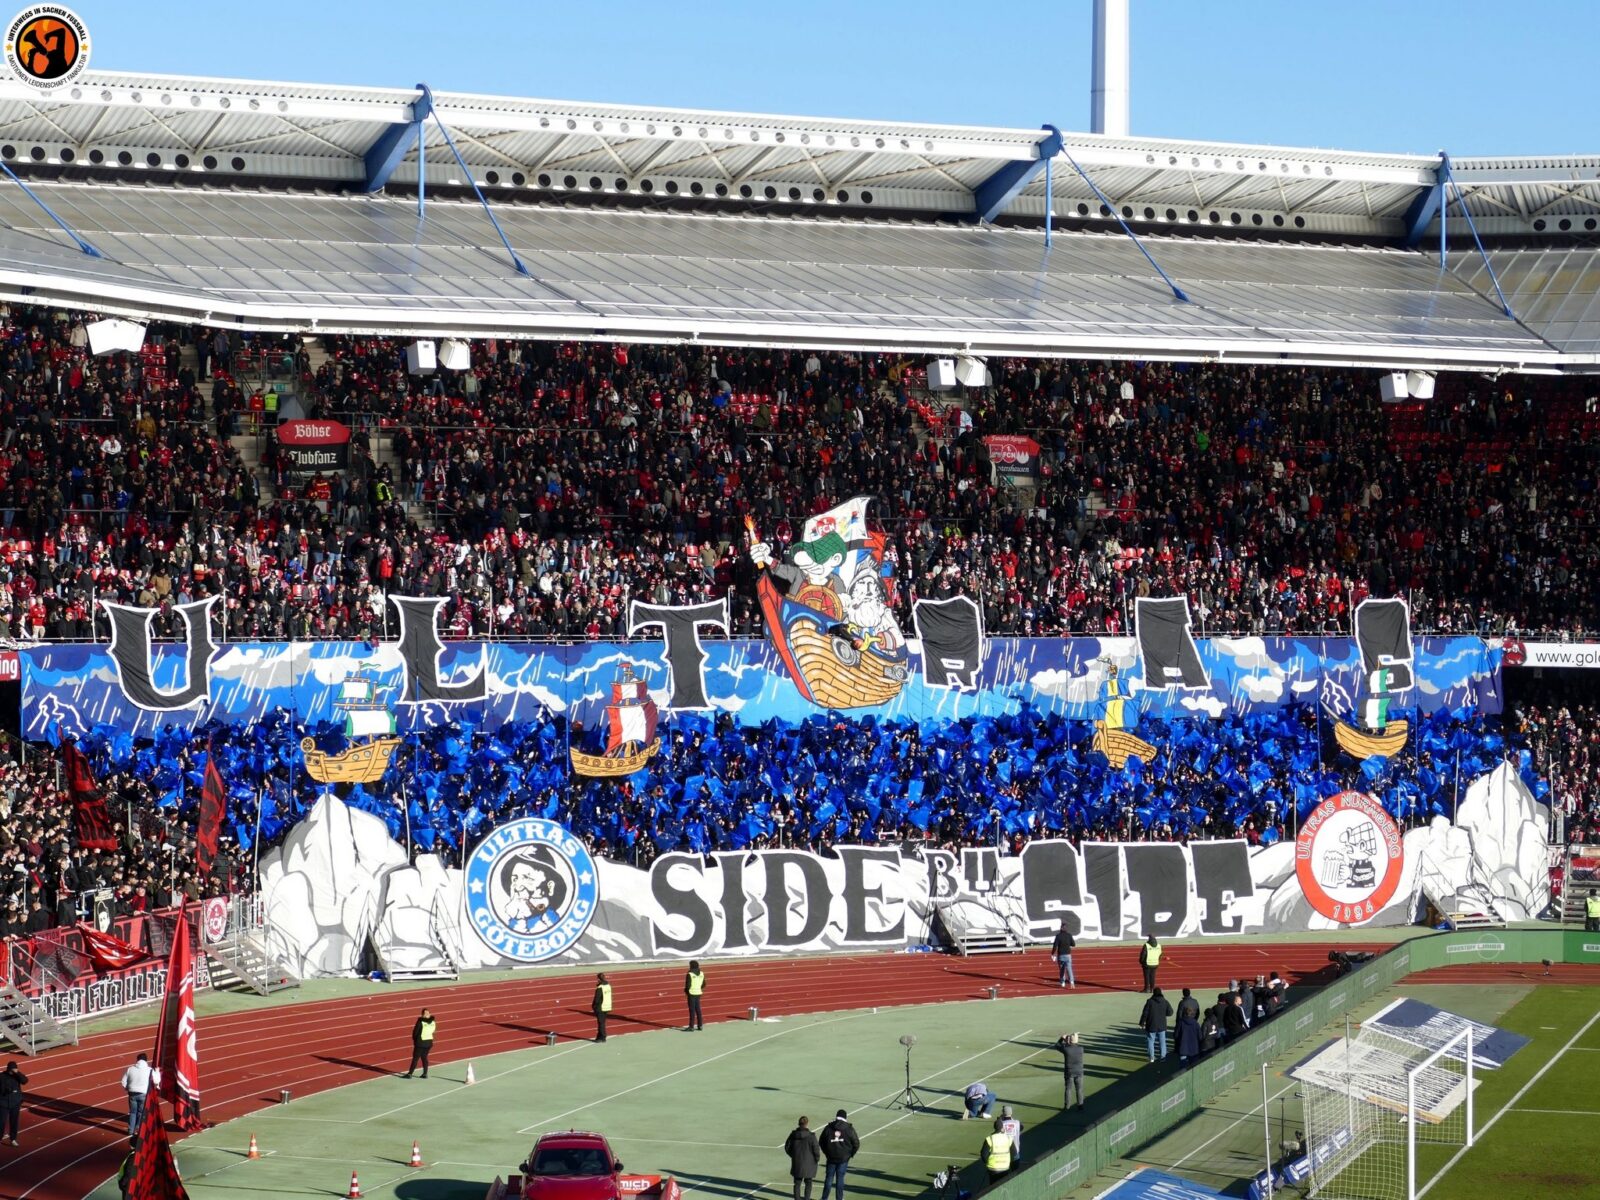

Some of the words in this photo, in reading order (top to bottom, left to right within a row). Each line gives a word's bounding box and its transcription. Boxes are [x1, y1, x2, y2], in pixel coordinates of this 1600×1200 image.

[295, 424, 331, 439] Böhse
[477, 822, 580, 862] ULTRAS
[1297, 801, 1336, 859] ULTRAS
[651, 844, 906, 957] SIDE
[1021, 839, 1255, 943] SIDE
[1333, 900, 1374, 919] 1994
[88, 974, 124, 1012] FÜR
[125, 969, 168, 1003] ULTR
